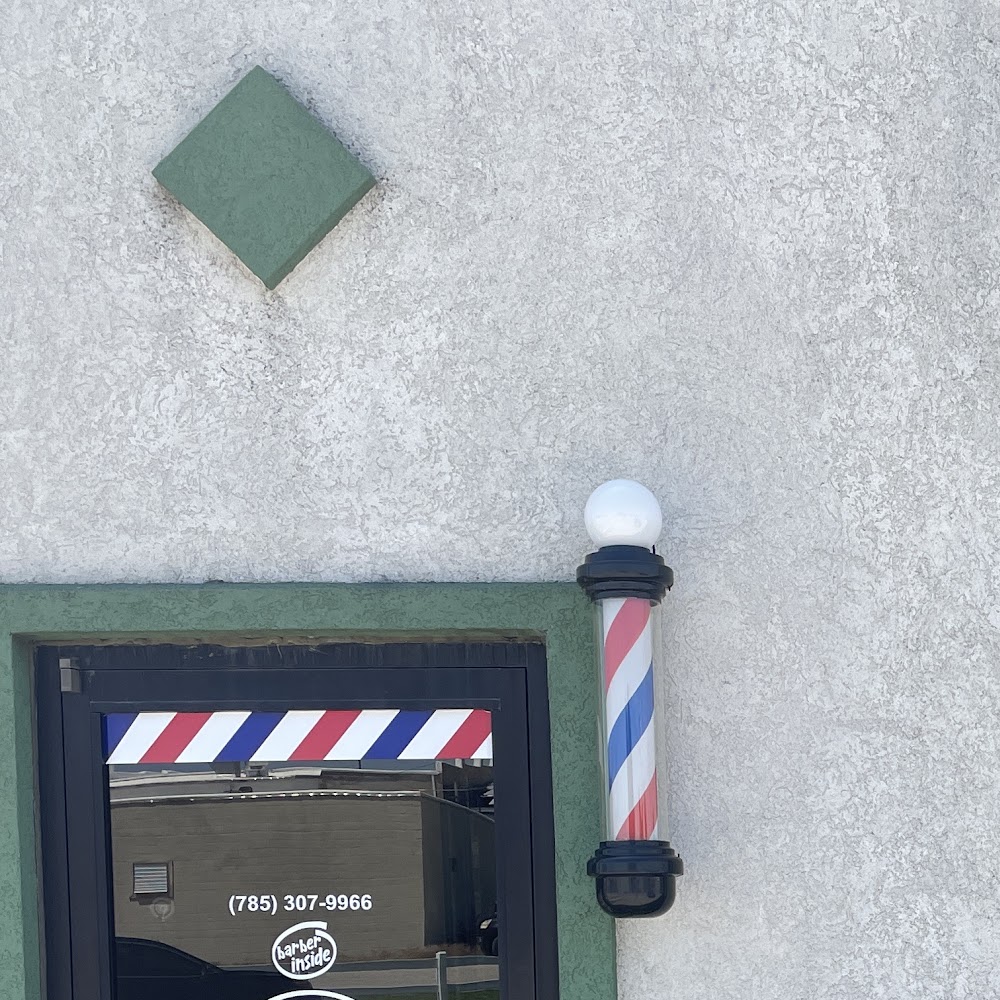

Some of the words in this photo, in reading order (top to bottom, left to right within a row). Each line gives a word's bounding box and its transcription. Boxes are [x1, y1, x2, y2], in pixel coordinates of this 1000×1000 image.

[228, 894, 278, 916] (785)
[283, 894, 373, 911] 307-9966
[276, 935, 322, 961] barber
[291, 946, 331, 974] inside
